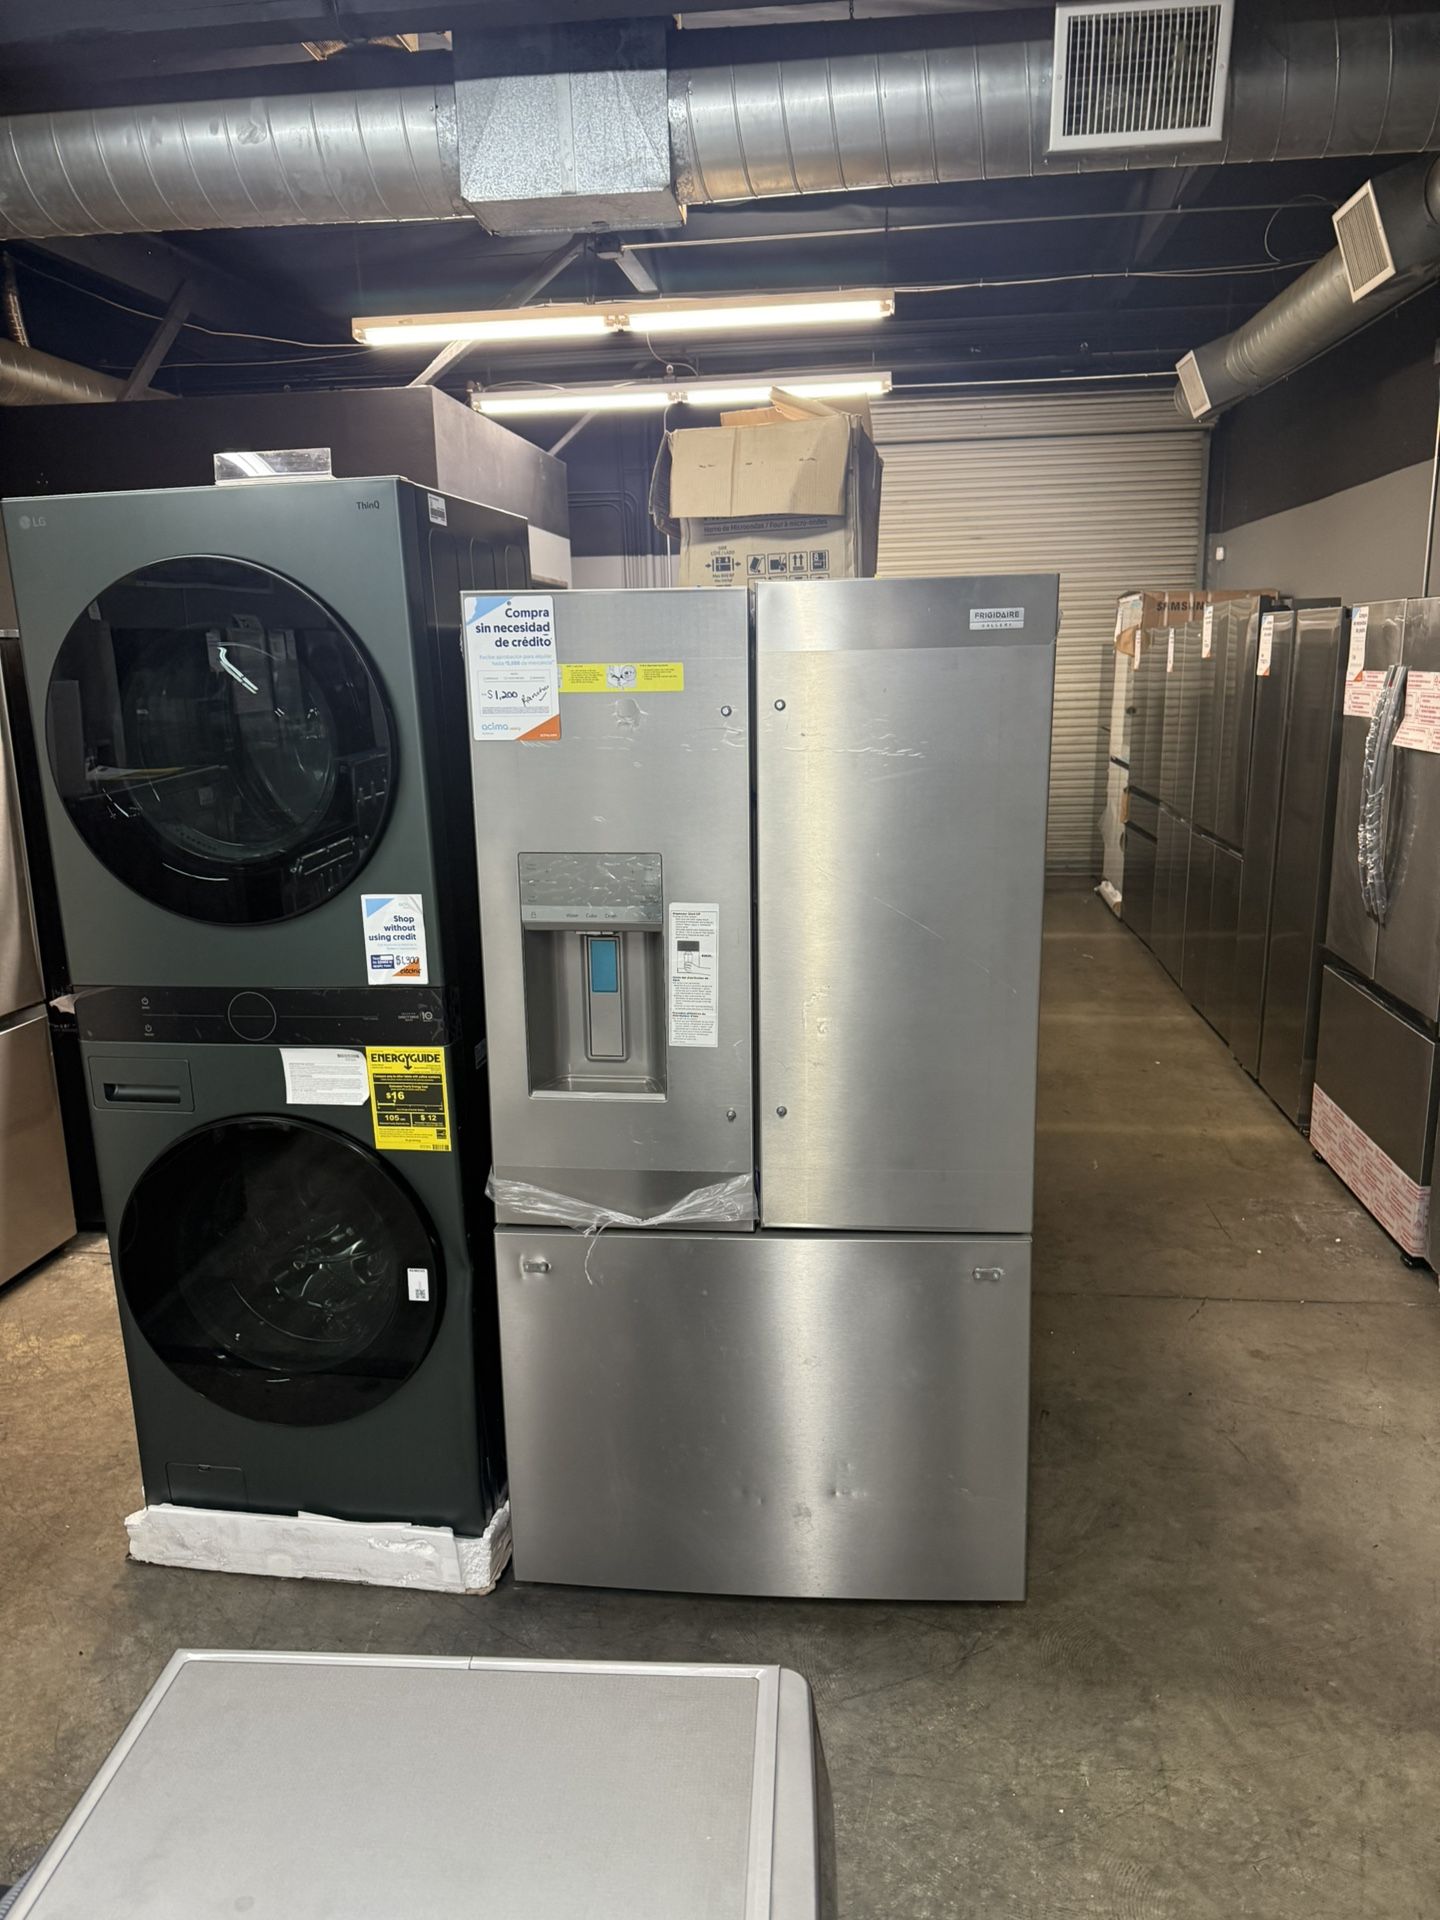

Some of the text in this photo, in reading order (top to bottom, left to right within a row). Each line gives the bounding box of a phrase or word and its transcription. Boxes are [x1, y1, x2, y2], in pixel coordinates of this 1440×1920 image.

[356, 500, 380, 510] ThinQ
[505, 608, 549, 620] Compra
[974, 611, 1019, 619] FRIGIDAIRE
[475, 622, 550, 633] sin necesidad
[495, 637, 551, 647] de crédito
[481, 722, 509, 731] acima
[393, 915, 414, 923] Shop
[369, 933, 391, 942] using
[371, 1053, 441, 1063] ENERGYGUIDE
[386, 1091, 405, 1100] $16
